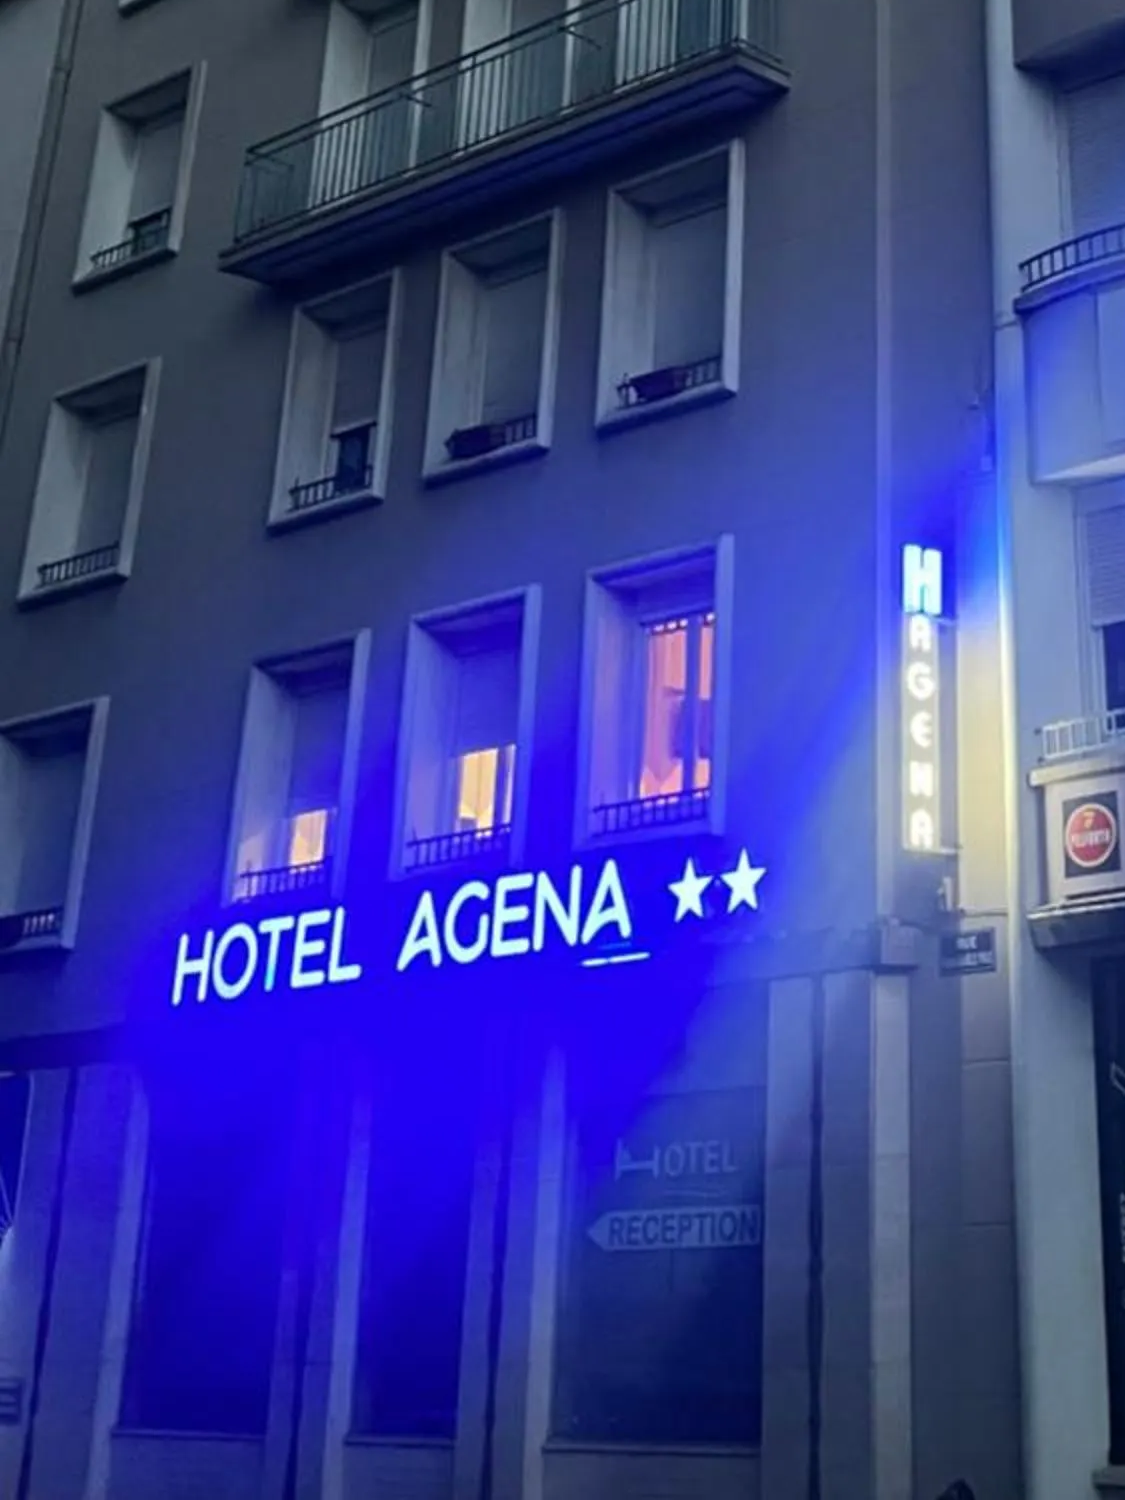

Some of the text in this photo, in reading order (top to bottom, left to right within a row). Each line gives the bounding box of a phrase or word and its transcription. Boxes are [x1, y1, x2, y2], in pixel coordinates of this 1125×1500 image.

[902, 544, 943, 617] H
[906, 613, 936, 850] AGENA
[172, 859, 632, 1006] HOTEL AGENA
[608, 1209, 759, 1246] RECEPTION
